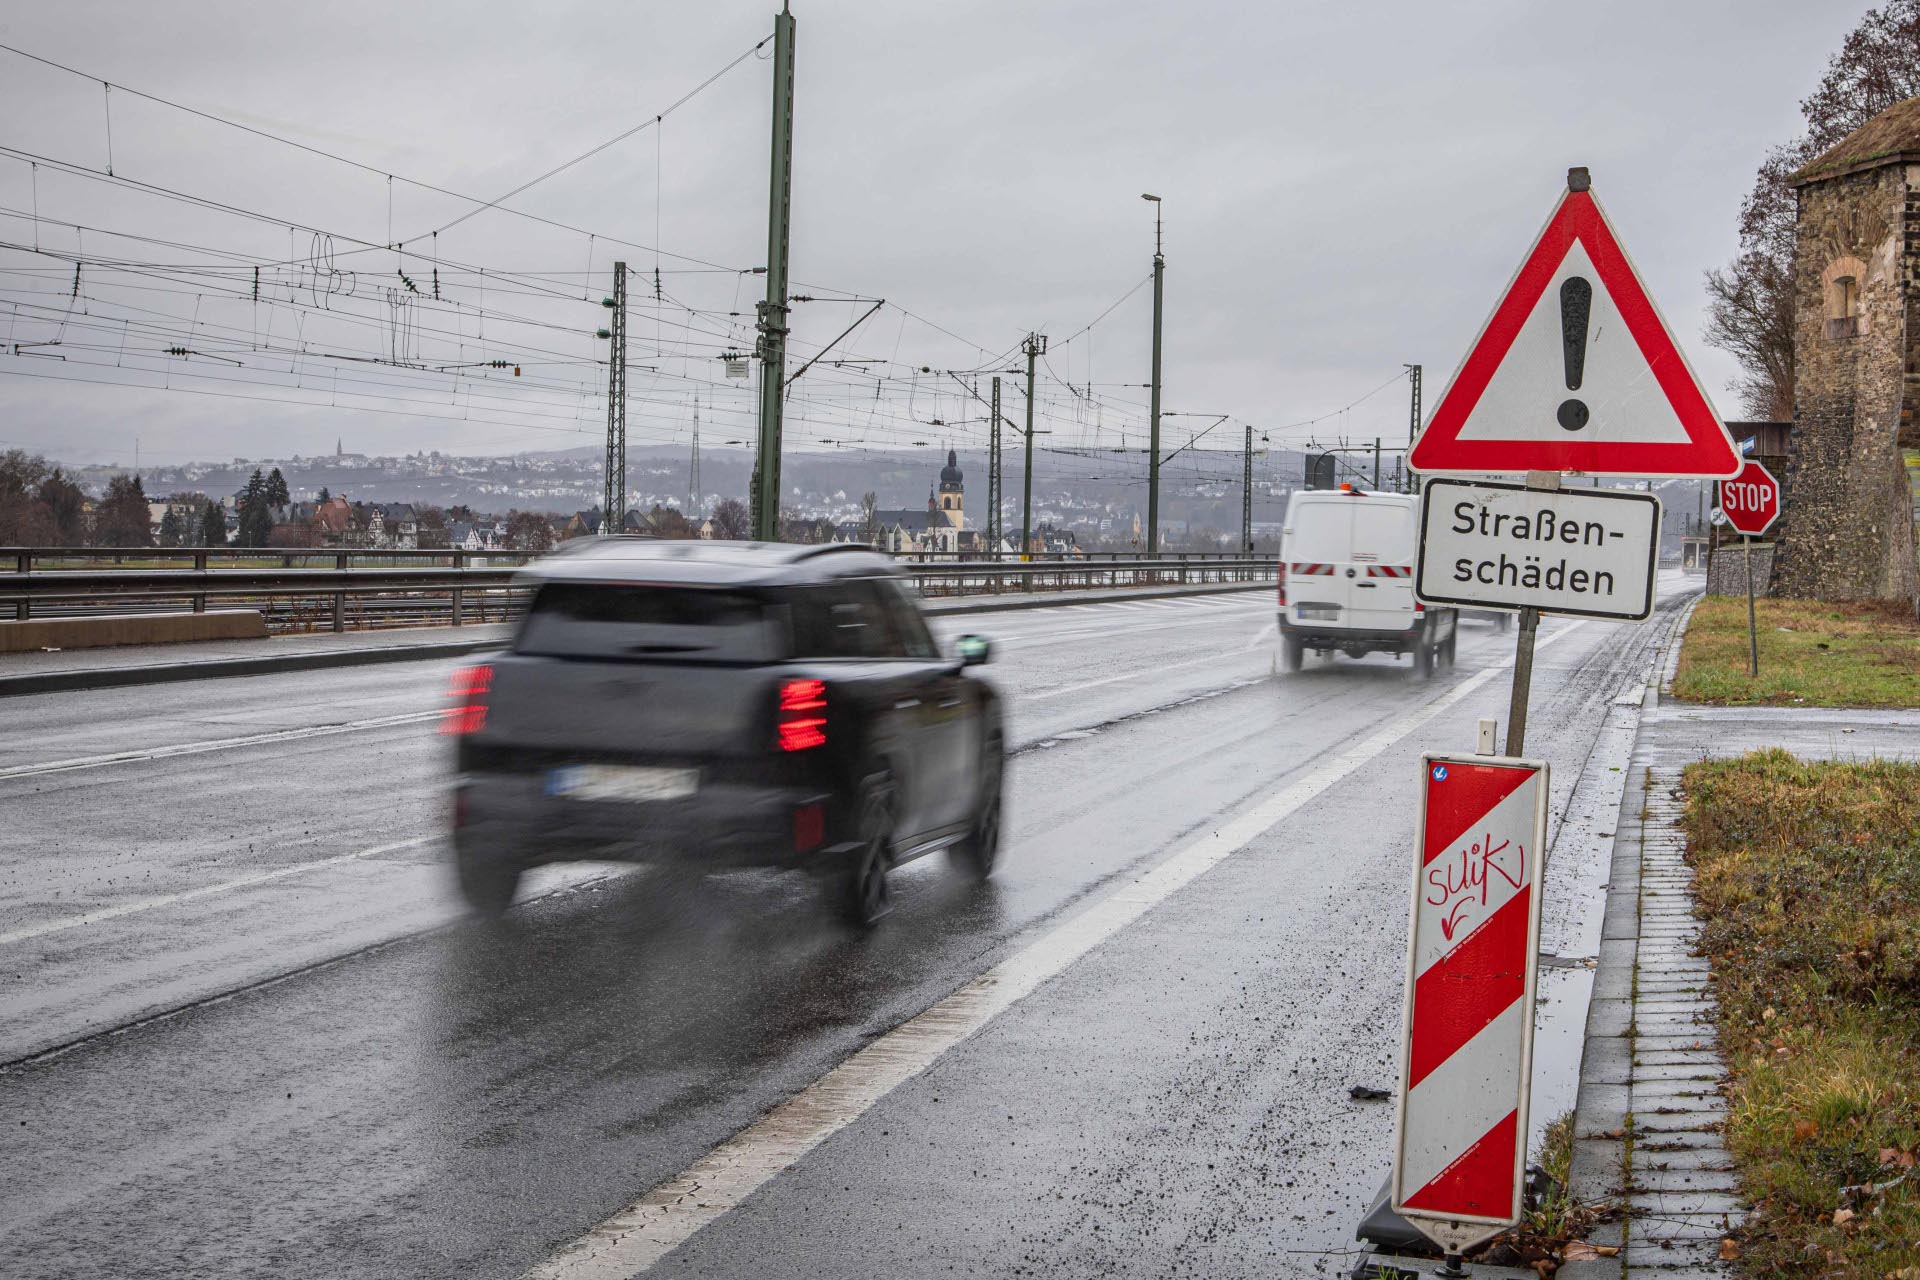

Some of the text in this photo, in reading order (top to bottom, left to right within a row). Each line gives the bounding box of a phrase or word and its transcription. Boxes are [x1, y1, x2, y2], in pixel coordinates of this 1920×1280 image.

[1725, 481, 1772, 512] STOP
[1452, 502, 1624, 546] Straßen-
[1712, 511, 1725, 521] 50
[1453, 554, 1614, 596] schäden
